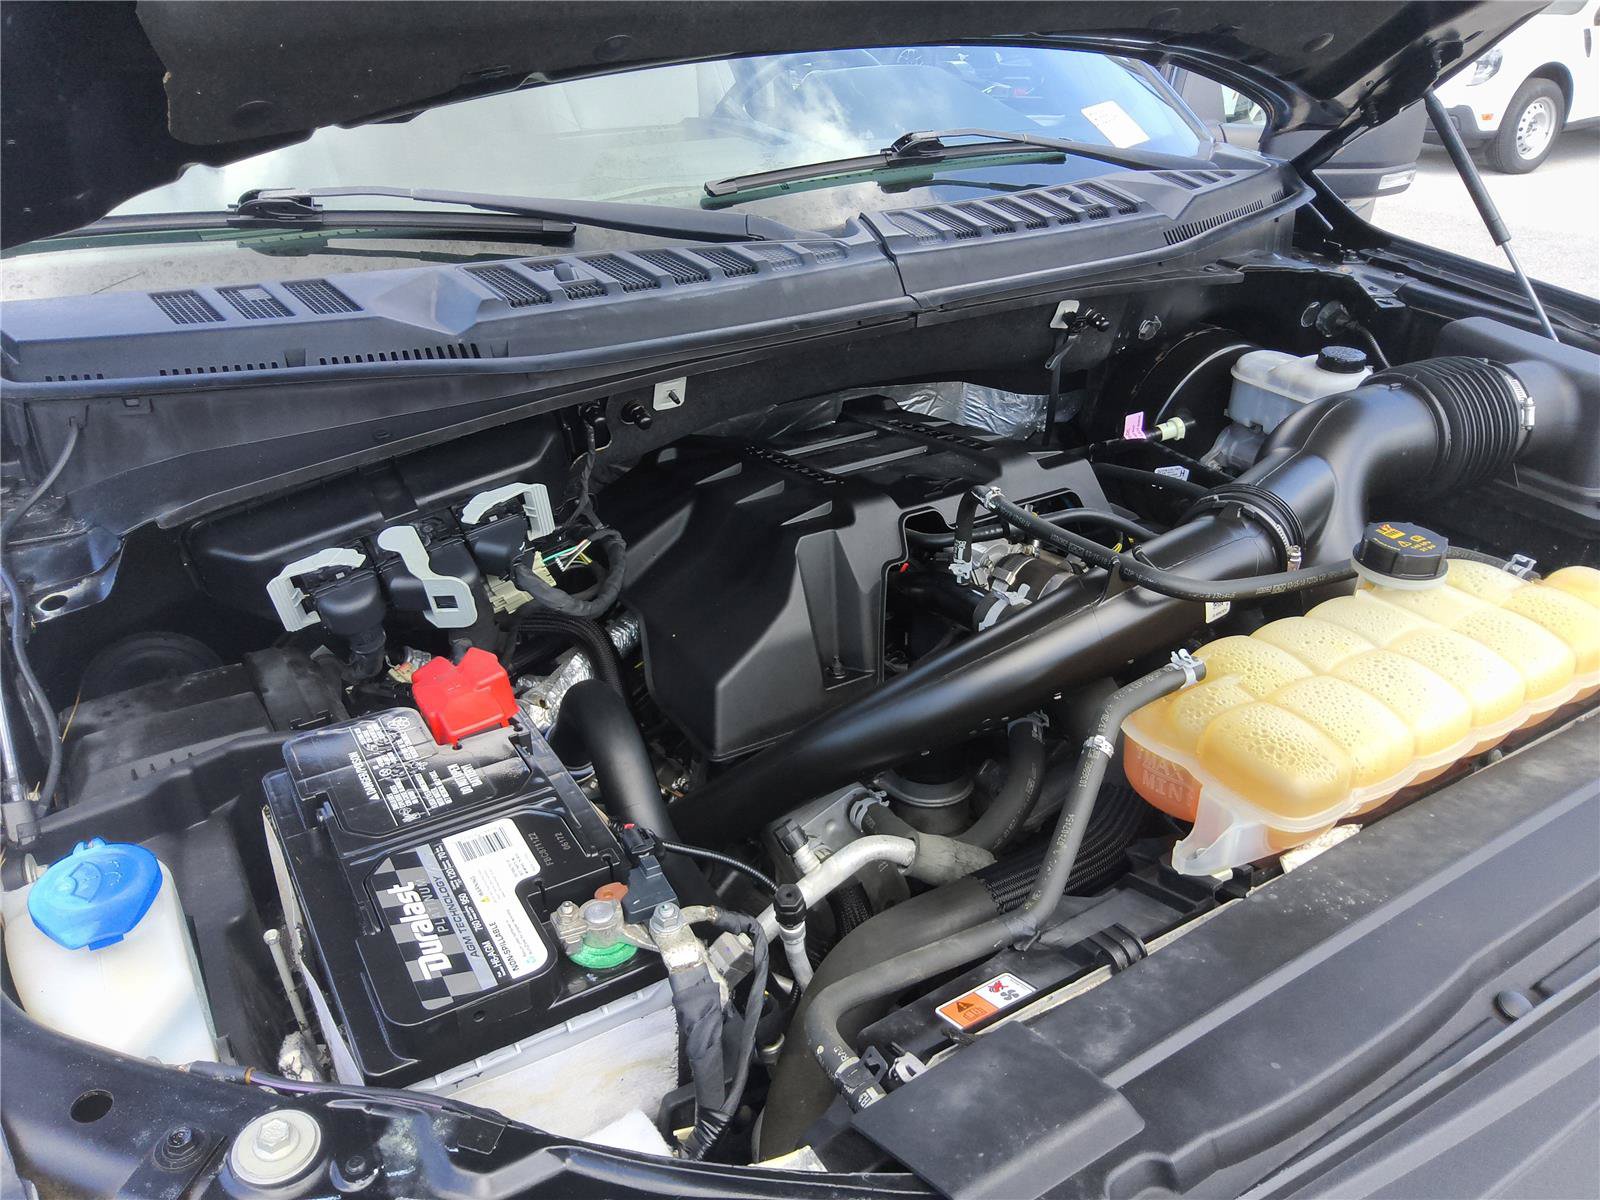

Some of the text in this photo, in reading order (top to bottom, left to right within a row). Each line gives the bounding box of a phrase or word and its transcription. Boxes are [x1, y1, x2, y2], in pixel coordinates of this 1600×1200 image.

[1143, 770, 1183, 802] MIN
[432, 876, 467, 933] TECHNOLOGY
[387, 881, 451, 979] Duralast
[462, 935, 479, 956] AGM
[488, 921, 519, 971] NON-SPILLABLE
[481, 940, 501, 967] H6-AGM
